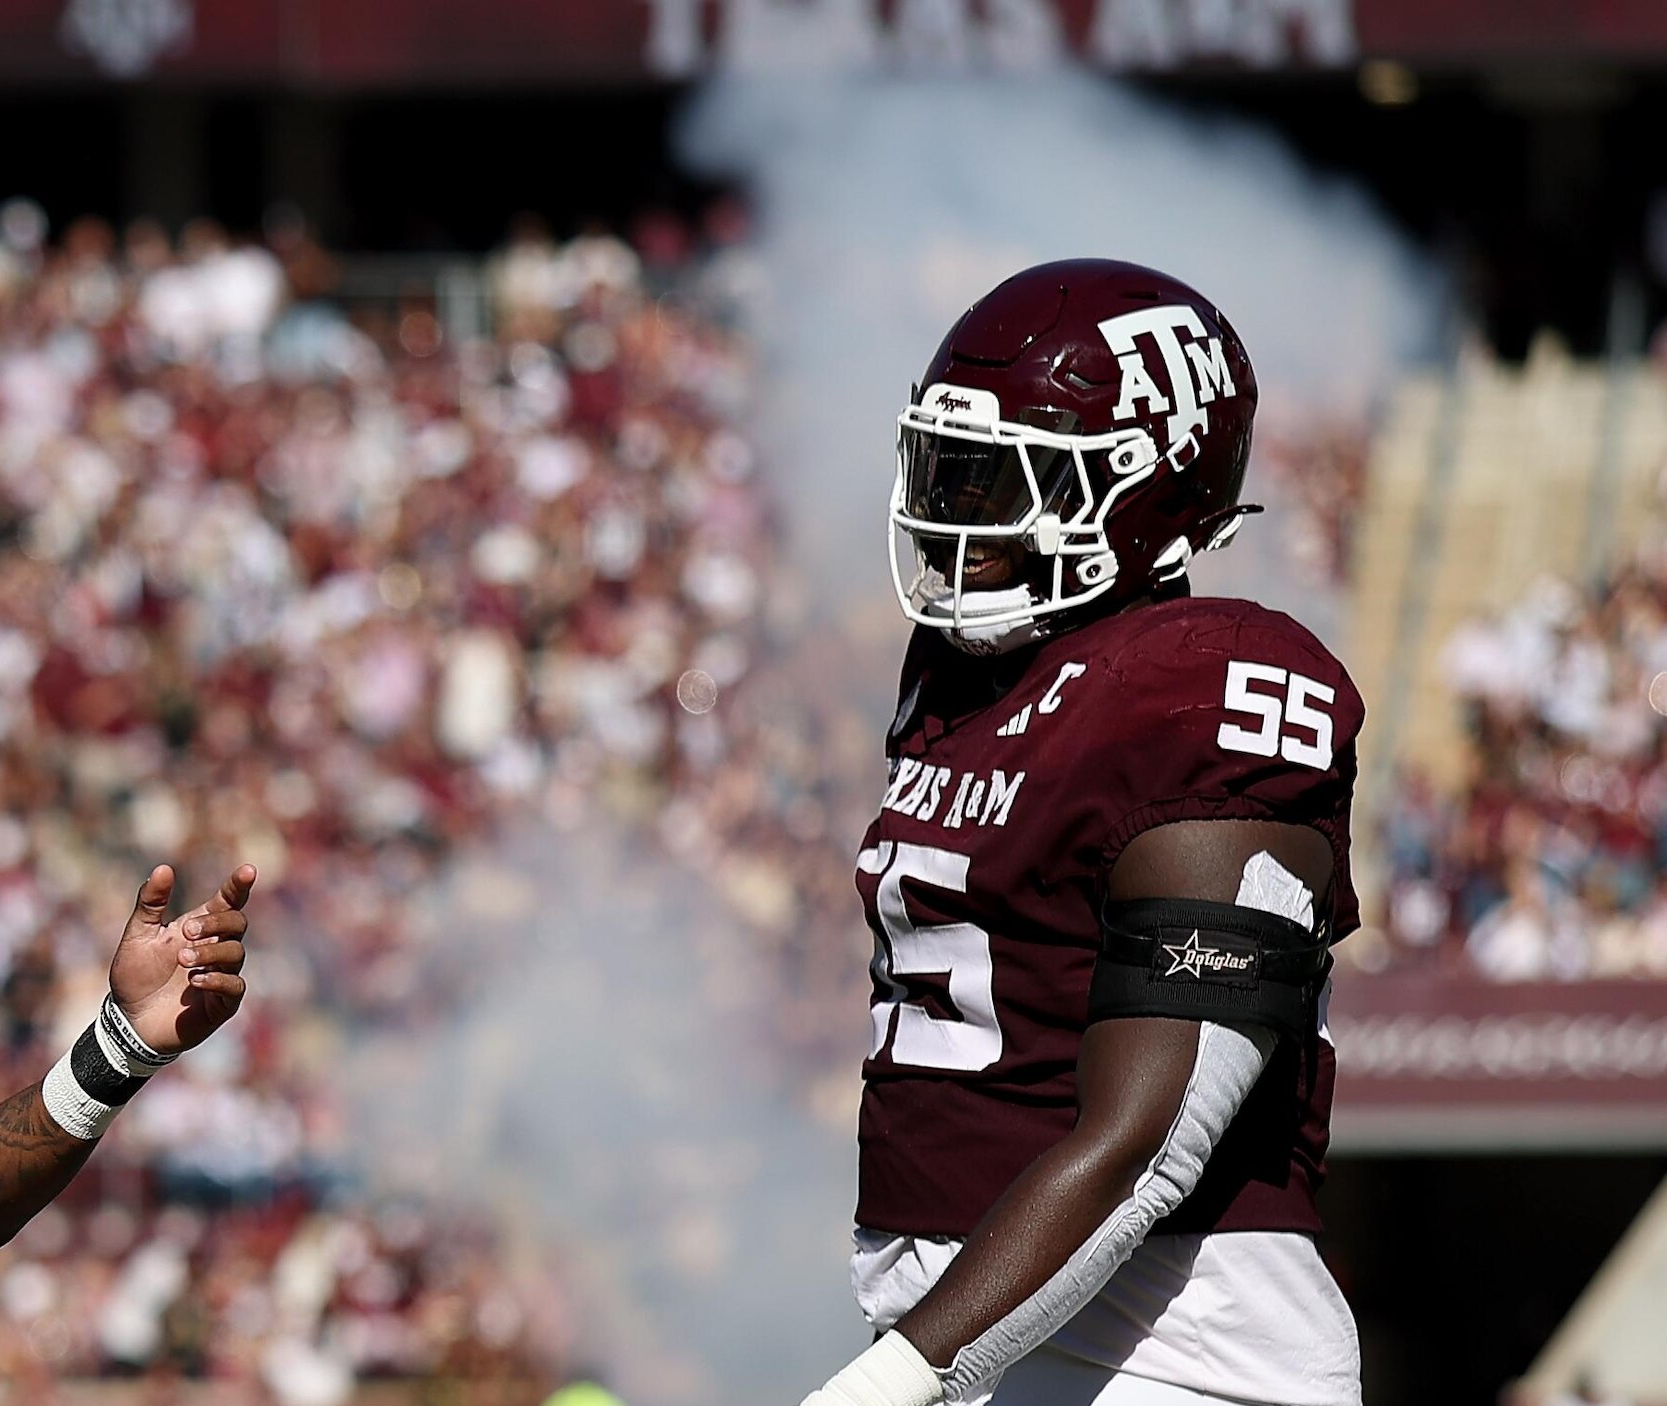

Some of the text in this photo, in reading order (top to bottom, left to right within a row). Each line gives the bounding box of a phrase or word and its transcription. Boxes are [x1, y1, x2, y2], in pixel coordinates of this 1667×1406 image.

[1038, 662, 1086, 714] C
[1217, 660, 1335, 771] 55
[882, 757, 1025, 829] XAS A&M
